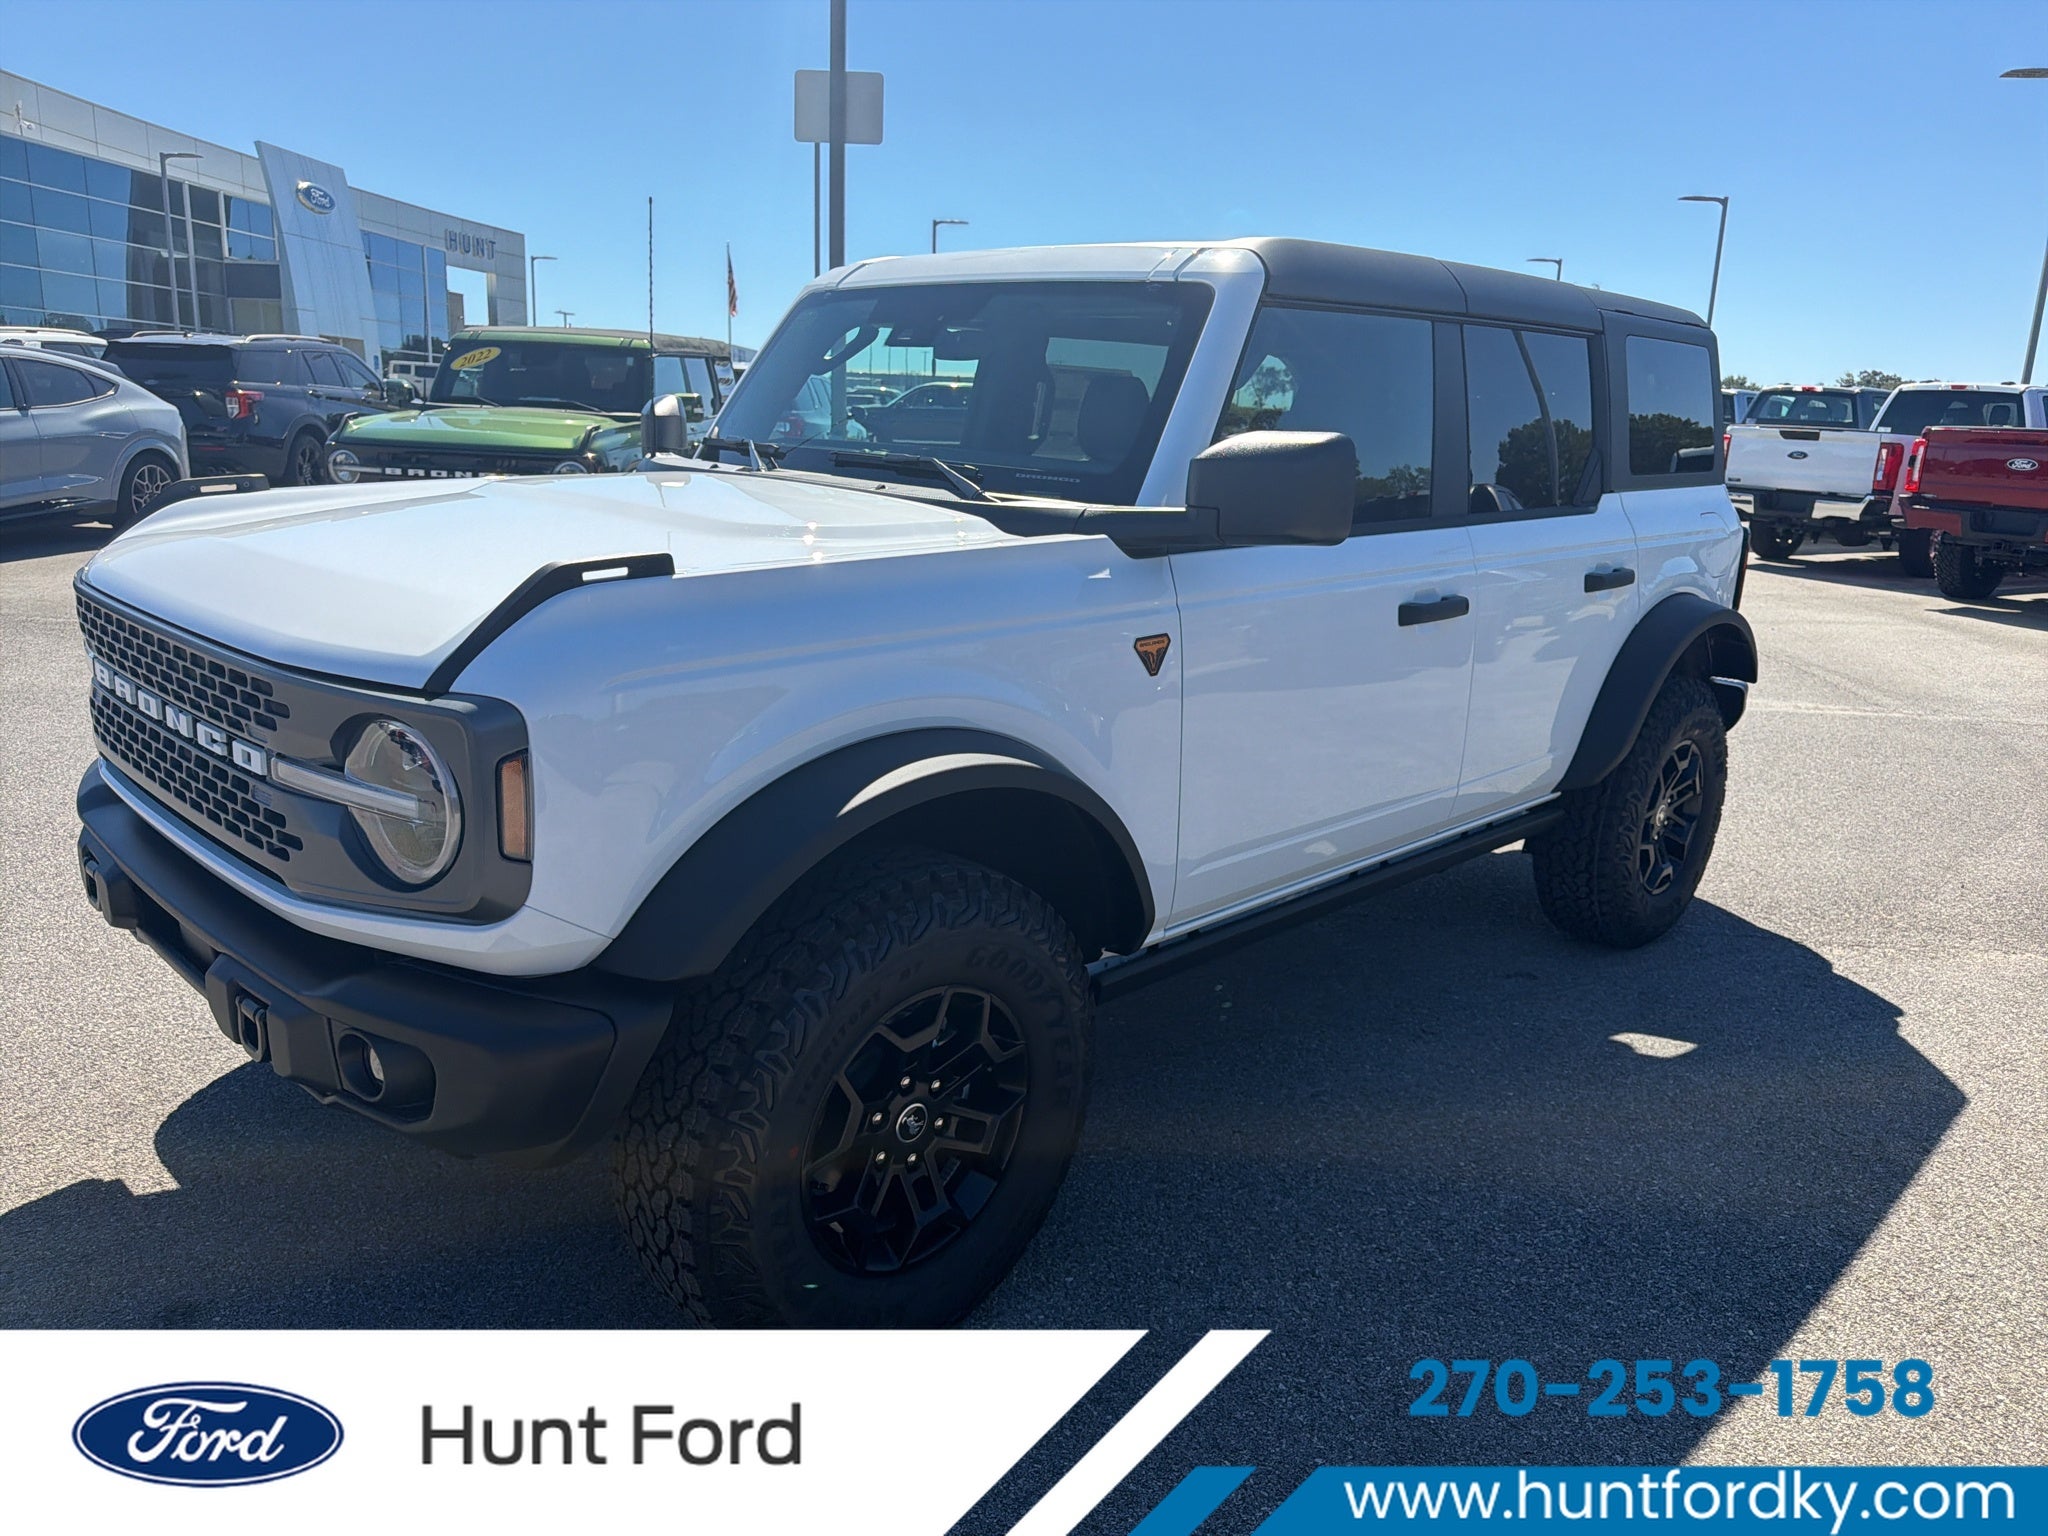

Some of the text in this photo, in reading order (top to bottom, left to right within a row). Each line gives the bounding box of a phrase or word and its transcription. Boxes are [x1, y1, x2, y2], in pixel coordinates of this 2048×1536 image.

[310, 188, 331, 208] Ford
[445, 228, 497, 261] HUNT
[460, 349, 492, 367] 2022
[384, 466, 520, 478] BRON
[2011, 459, 2033, 470] Ford
[93, 658, 268, 776] BRONCO
